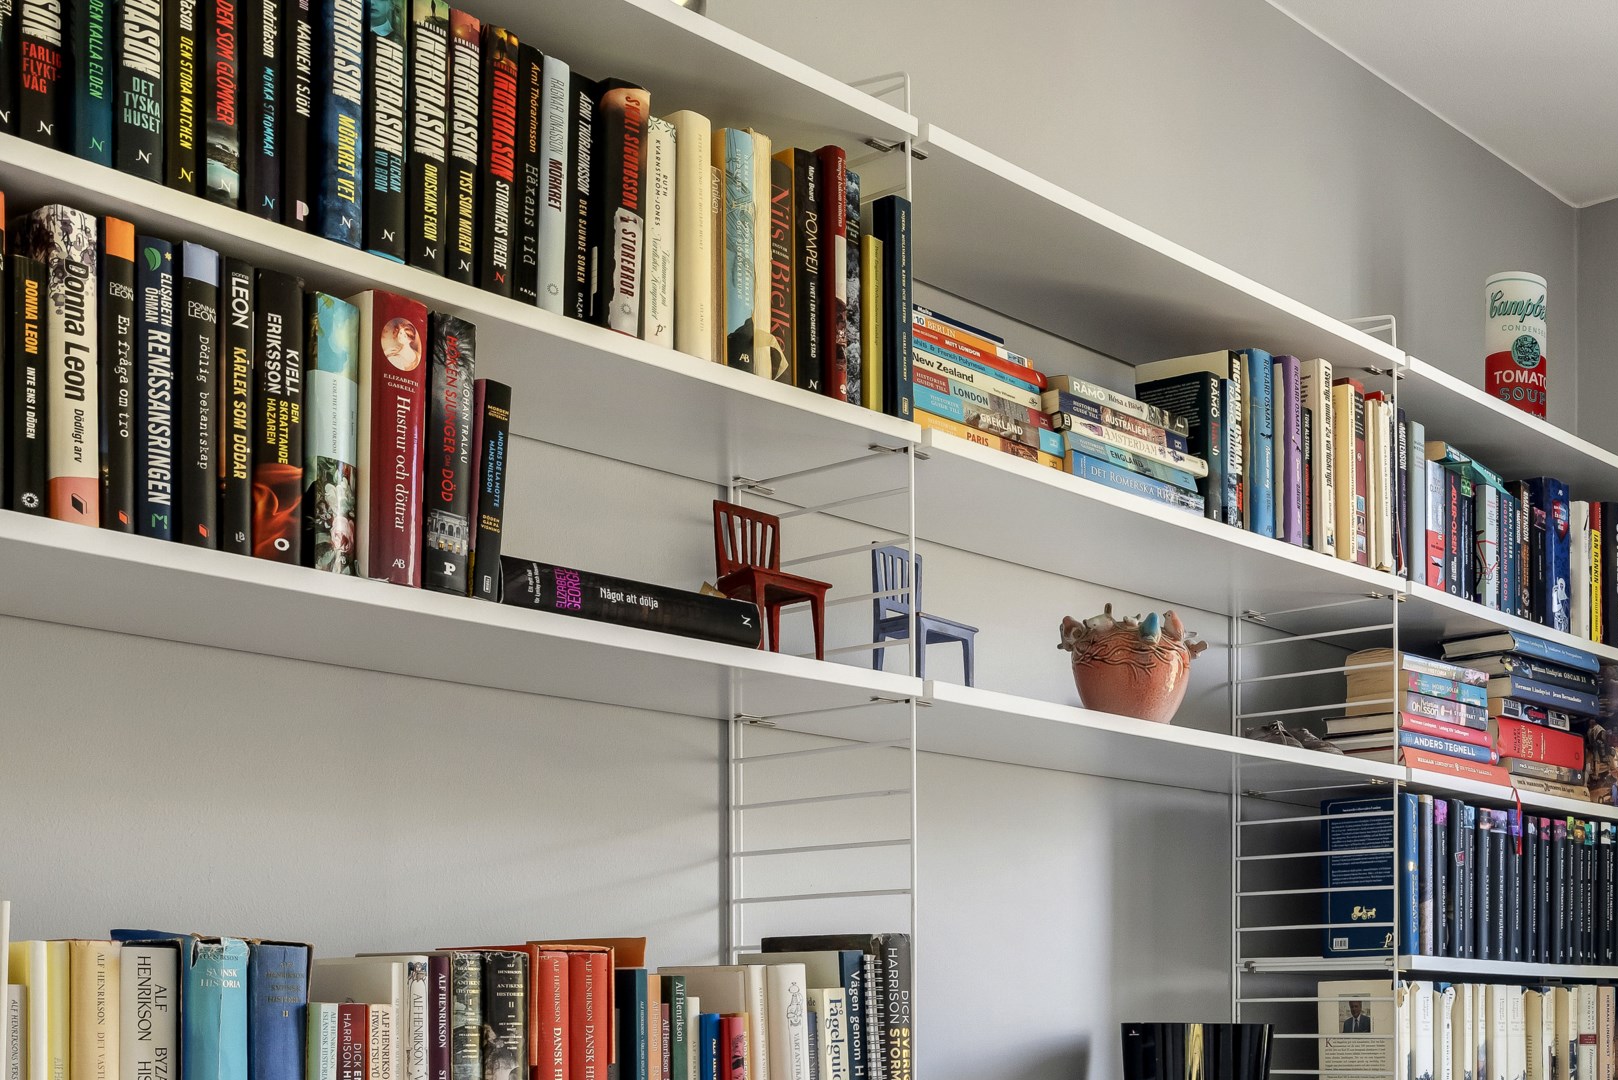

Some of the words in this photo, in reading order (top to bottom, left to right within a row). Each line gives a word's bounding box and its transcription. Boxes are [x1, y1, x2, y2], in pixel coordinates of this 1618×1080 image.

[89, 22, 104, 61] KALLA
[216, 28, 234, 61] SOM
[297, 20, 312, 72] MANNEN
[132, 76, 154, 92] DET
[180, 59, 193, 97] STORA
[216, 61, 234, 126] GLÖMMER
[124, 91, 161, 118] TYSKA
[124, 108, 161, 134] HUSET
[180, 96, 193, 150] MATCHEN
[337, 113, 358, 177] MÖRKRET
[337, 176, 355, 204] VET
[494, 181, 510, 237] STORMENS
[711, 171, 721, 214] Antiken
[771, 184, 790, 241] Nils
[493, 236, 508, 270] VREDE
[806, 210, 818, 274] POMPEJI
[620, 228, 637, 298] STOREBROR
[25, 279, 38, 320] DONNA
[64, 259, 89, 337] Donna
[145, 287, 158, 323] ÖHMAN
[160, 272, 173, 327] ELISABETH
[231, 278, 249, 329] LEON
[25, 323, 38, 355] LEON
[927, 319, 956, 338] BERLIN
[64, 341, 90, 402] Leon
[233, 346, 250, 396] KÄRLEK
[267, 312, 282, 395] ERIKSSON
[286, 348, 299, 396] KJELL
[936, 361, 974, 383] Zealand
[233, 399, 247, 430] SOM
[461, 382, 473, 421] JOHAN
[953, 386, 989, 406] LONDON
[26, 411, 37, 439] DÖDEN
[73, 408, 84, 445] Dödligt
[147, 329, 174, 506] RENÄSSANSRINGEN
[196, 391, 209, 470] bekantskap
[396, 395, 411, 453] Hustrur
[233, 432, 250, 480] DÖDAR
[460, 425, 471, 464] TRALAU
[966, 432, 989, 446] PARIS
[1103, 426, 1158, 456] AMSTERDAM
[395, 456, 410, 481] och
[441, 469, 456, 502] DÖD
[1110, 471, 1154, 494] ROMERSKA
[395, 483, 410, 533] döttrar
[600, 586, 624, 604] Något
[639, 595, 659, 610] dölja
[1414, 736, 1444, 750] ANDERS
[1445, 742, 1476, 756] TEGNELL
[137, 955, 152, 1042] HENRIKSON
[155, 983, 168, 1013] ALF
[413, 993, 423, 1011] ALF
[553, 976, 561, 1023] HENRIKSON
[585, 976, 593, 1022] HENRIKSON
[848, 970, 861, 1011] Vägen
[888, 948, 899, 1025] HARRISON
[438, 991, 447, 1049] HENRIKSON
[901, 990, 910, 1025] DICK
[343, 1013, 352, 1067] HARRISON
[353, 1043, 362, 1067] DICK
[413, 1011, 423, 1066] HENRIKSON
[553, 1026, 563, 1072] DANSK
[585, 1025, 594, 1063] DANSK
[850, 1014, 862, 1061] genom
